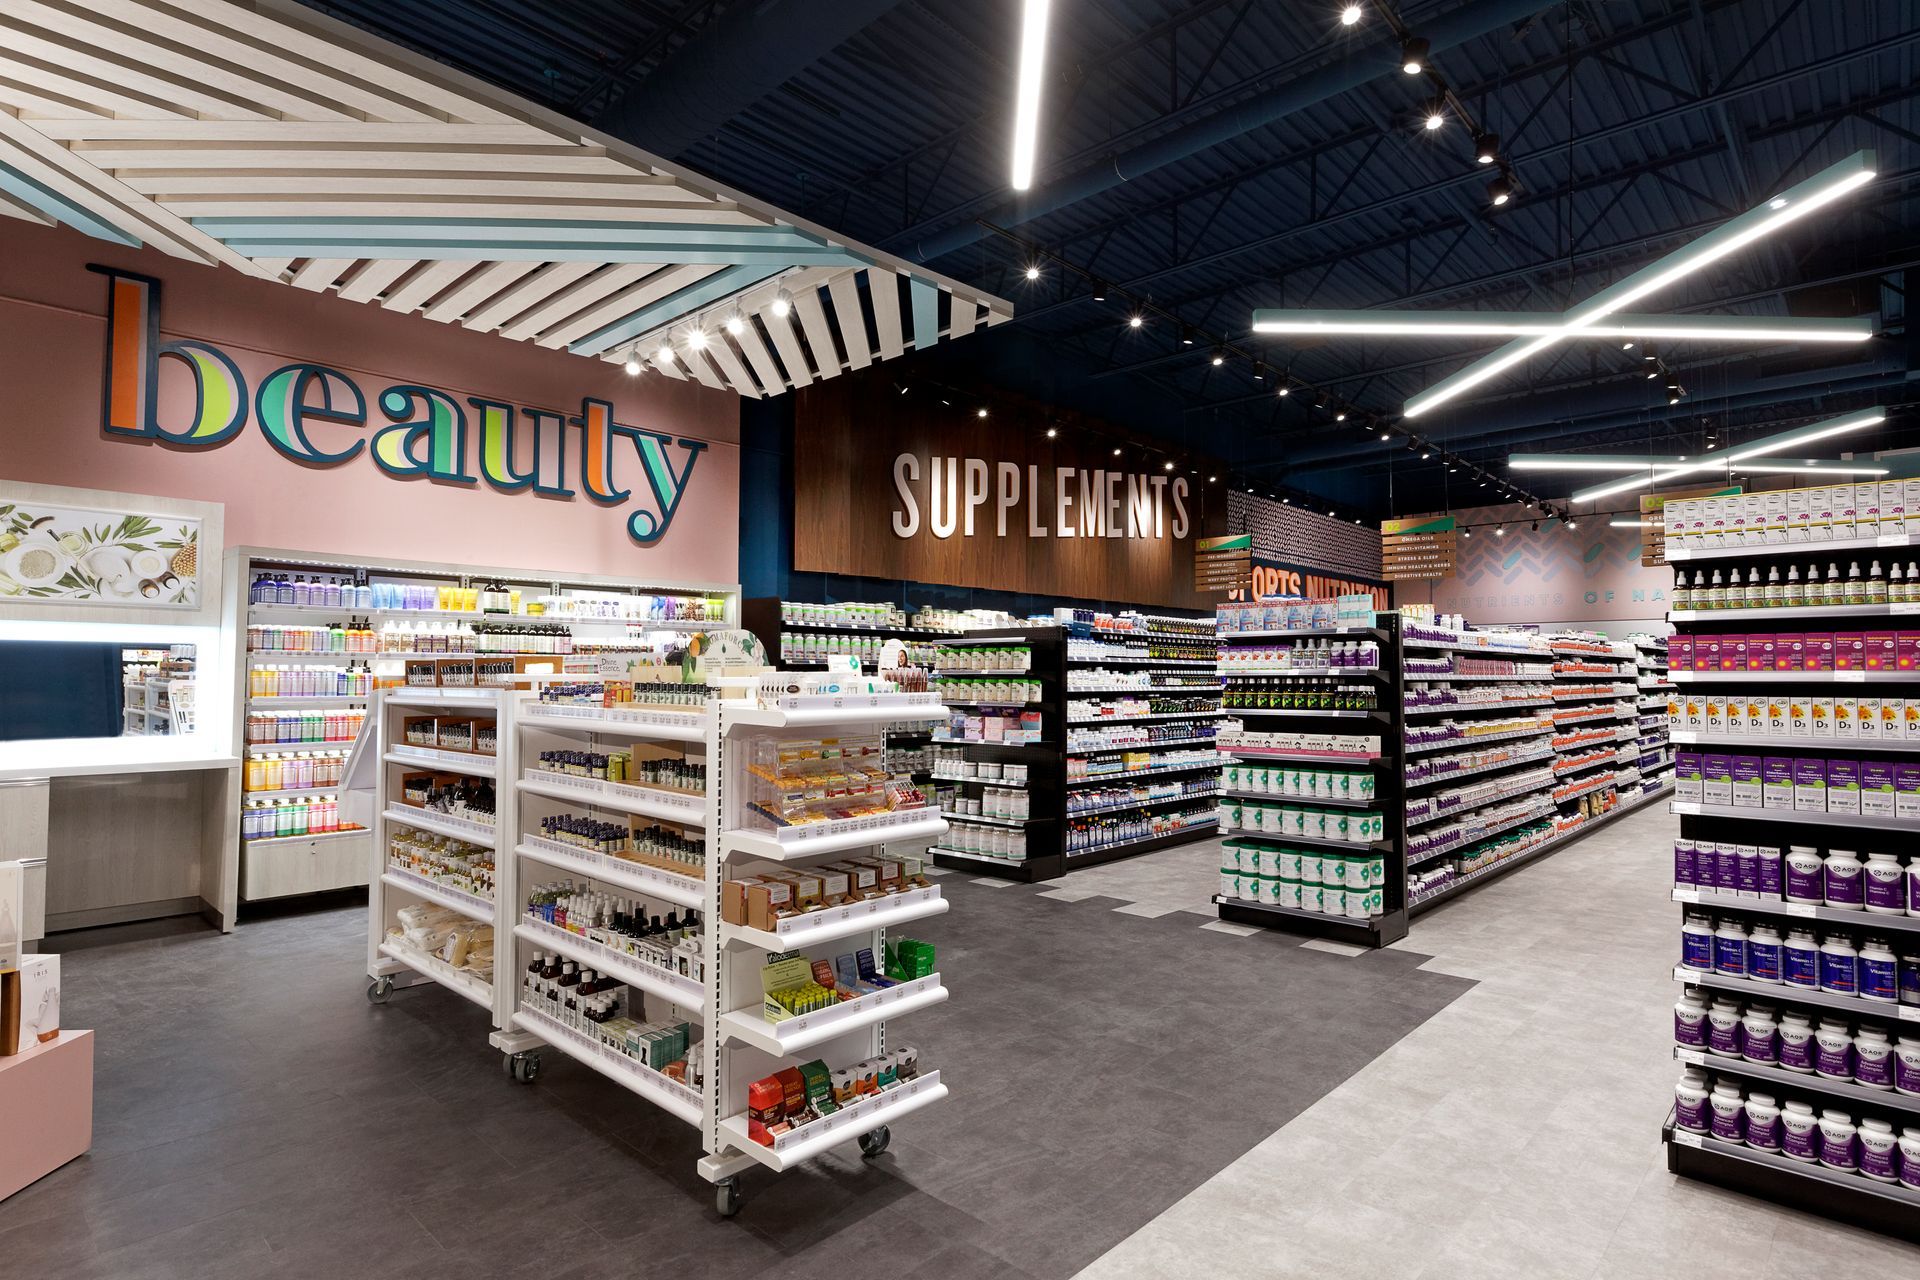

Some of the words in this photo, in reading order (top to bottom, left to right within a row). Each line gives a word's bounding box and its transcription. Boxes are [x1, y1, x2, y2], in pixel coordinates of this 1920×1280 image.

[85, 262, 709, 543] beauty
[892, 452, 1189, 540] SUPPLEMENTS
[1385, 522, 1400, 532] 02
[1448, 592, 1564, 609] NUTRIENTS
[1584, 590, 1615, 604] OF
[1632, 588, 1665, 602] NA
[34, 969, 48, 978] IRIS
[1678, 1106, 1696, 1114] Advanced
[1866, 1152, 1888, 1160] Advanced
